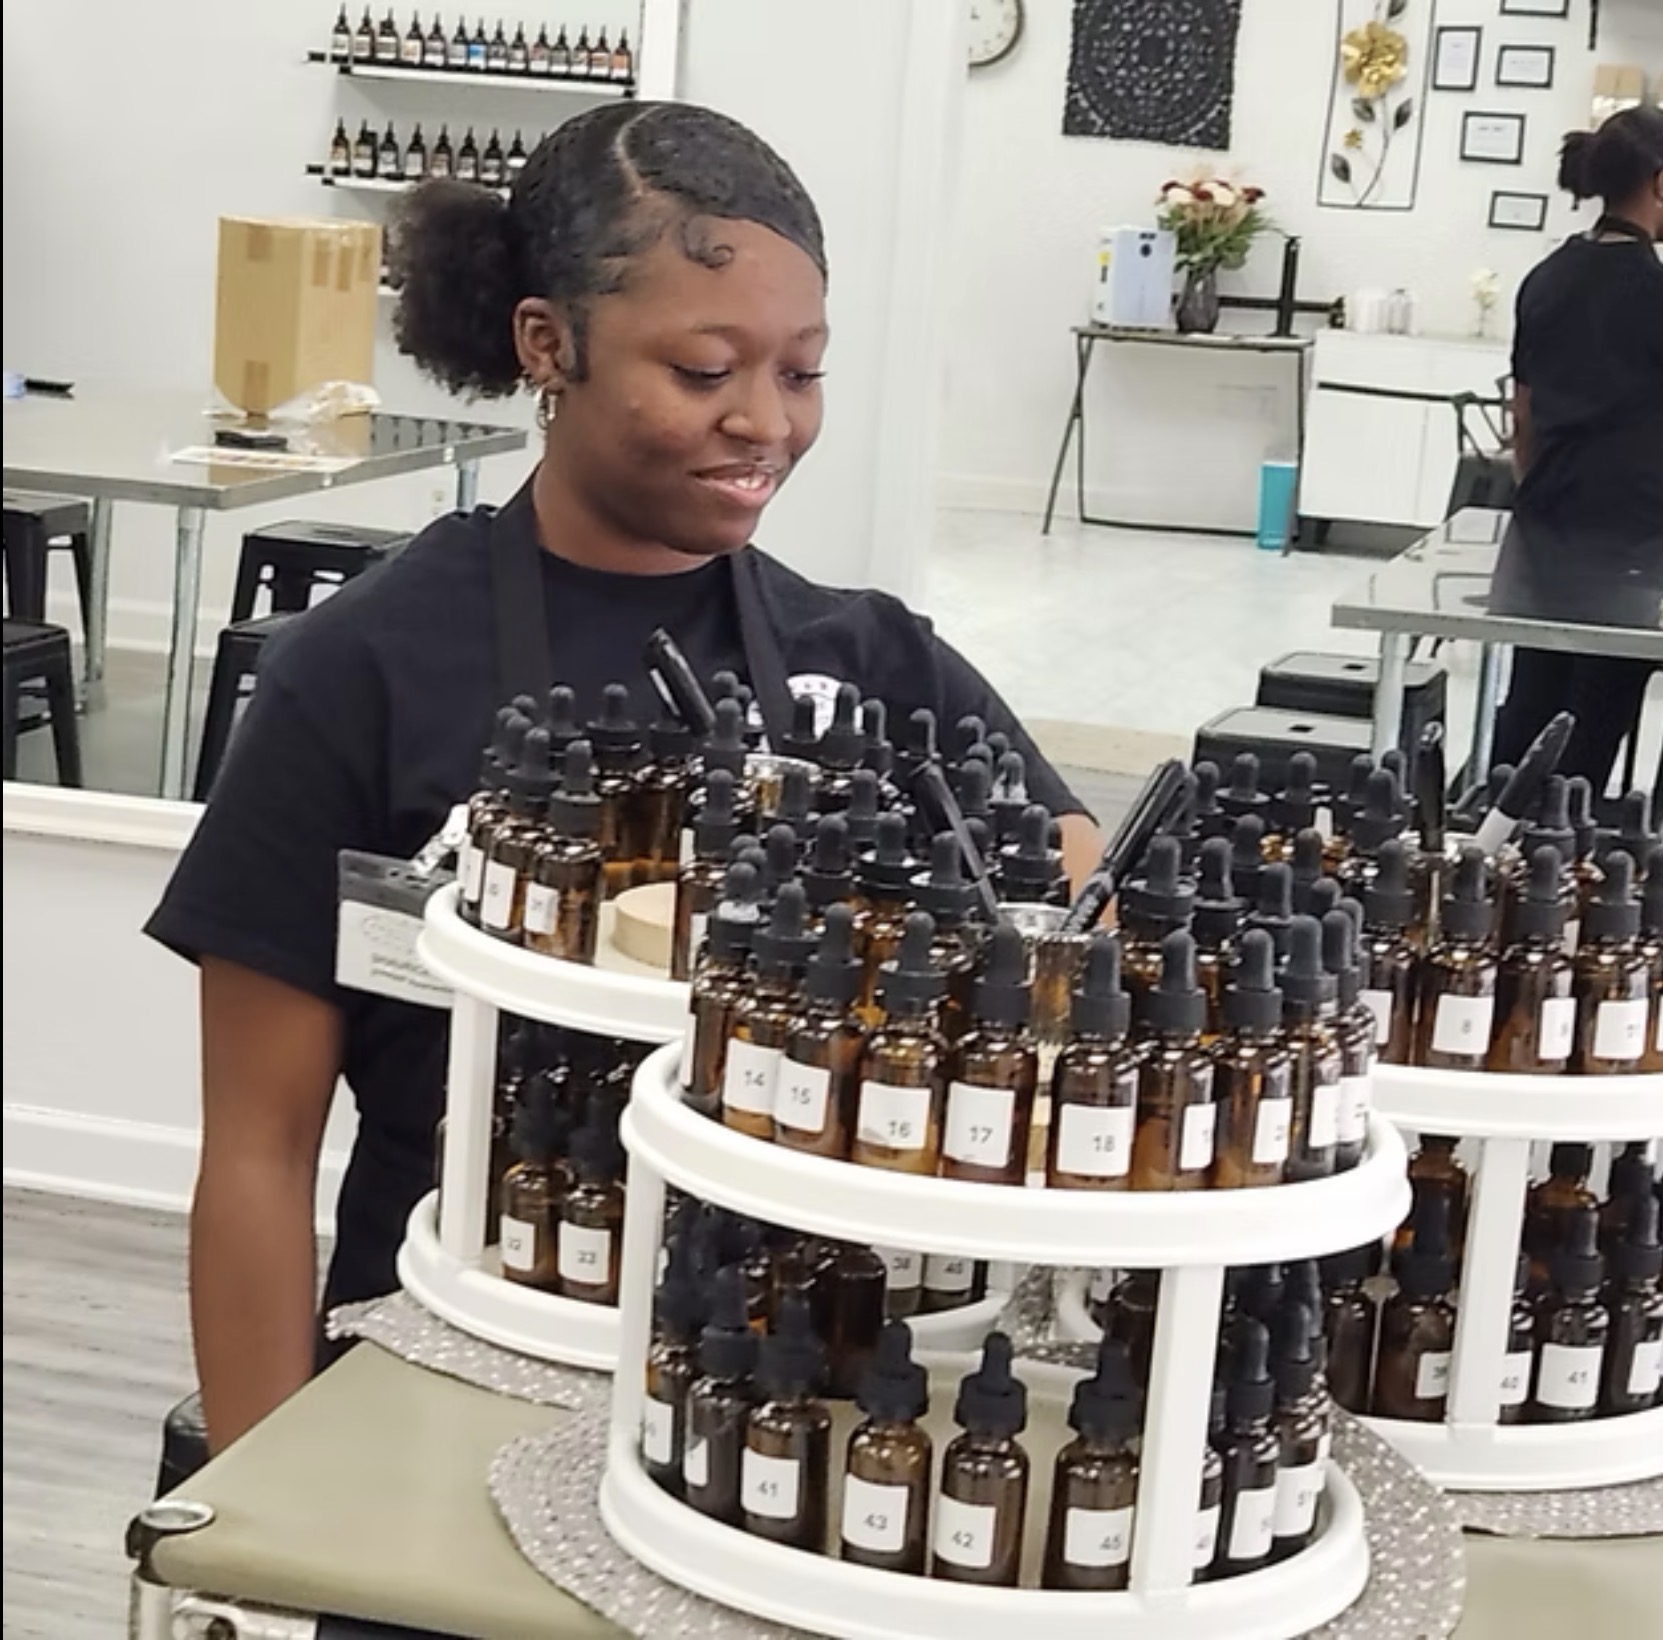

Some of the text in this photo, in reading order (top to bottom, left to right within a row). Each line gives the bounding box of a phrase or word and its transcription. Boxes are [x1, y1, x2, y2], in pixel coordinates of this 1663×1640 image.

[744, 1069, 765, 1087] 14
[790, 1085, 811, 1105] 15
[888, 1120, 912, 1138] 16
[969, 1126, 993, 1144] 17
[1093, 1134, 1116, 1153] 18
[757, 1480, 779, 1498] 41
[864, 1513, 888, 1532] 43
[952, 1530, 975, 1549] 42
